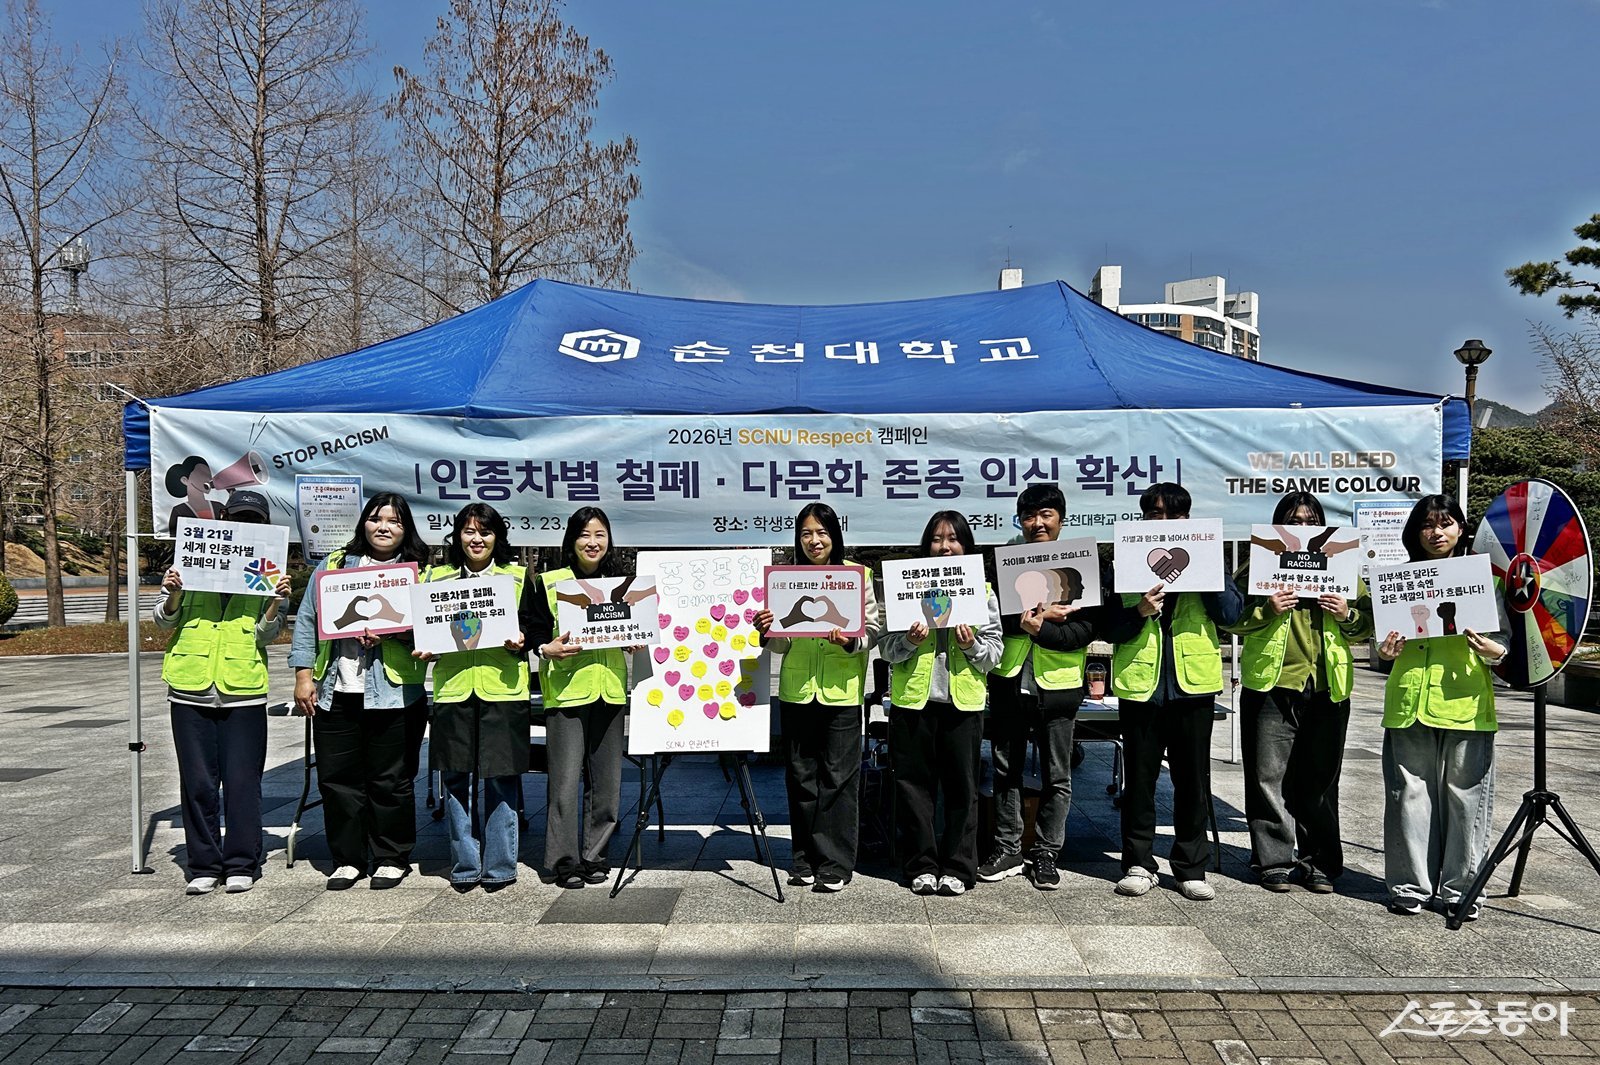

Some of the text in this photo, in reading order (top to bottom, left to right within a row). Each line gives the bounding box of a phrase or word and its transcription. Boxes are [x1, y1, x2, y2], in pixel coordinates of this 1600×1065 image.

[669, 336, 1040, 365] 순천대학교
[669, 426, 929, 448] 2026년 SCNU Respect 캠페인
[273, 426, 389, 470] STOP RACISM
[1248, 452, 1396, 470] WE ALL BLEED
[431, 459, 600, 502] 인종차별
[616, 459, 700, 501] 철폐
[743, 457, 868, 500] 다문화
[883, 458, 964, 500] 존중
[980, 457, 1060, 498] 인식
[1076, 454, 1164, 497] 확산
[1226, 476, 1421, 495] THE SAME COLOUR
[521, 516, 535, 530] 3.
[713, 516, 748, 533] 장소:
[754, 515, 797, 532] 학생회
[968, 513, 1003, 530] 주최:
[184, 527, 233, 541] 3월 21일
[1122, 533, 1215, 543] 차별과 혐오를 넘어서 하나로
[183, 542, 254, 557] 세계 인종차별
[181, 555, 231, 570] 철폐의 날
[1002, 556, 1026, 567] 차이를
[1027, 553, 1050, 564] 차별할
[1060, 550, 1092, 562] 없습니다.
[902, 568, 940, 579] 인종차별
[1272, 573, 1295, 581] 차별과
[1297, 574, 1319, 582] 혐오를
[1378, 567, 1439, 583] 피부색은 달라도
[324, 577, 410, 593] 서로 다르지만 사랑해요.
[772, 581, 857, 590] 서로 다르지만 사랑해요.
[907, 578, 964, 590] 다양성을 인정해
[1256, 582, 1349, 593] 인종차별 없는 세상을 만들자
[1379, 579, 1434, 594] 우리들 몸 속엔
[430, 588, 469, 602] 인종차별
[897, 586, 974, 601] 함께 더불어 사는 우리
[1380, 584, 1485, 604] 같은 색깔의 피가 흐릅니다!
[435, 599, 494, 613] 다양성을 인정해
[425, 608, 505, 625] 함께 더불어 사는 우리
[582, 623, 639, 635] 차별과 혐오를 넘어
[569, 631, 653, 645] 인종차별 없는 세상을 만들자
[666, 741, 685, 749] SCNU
